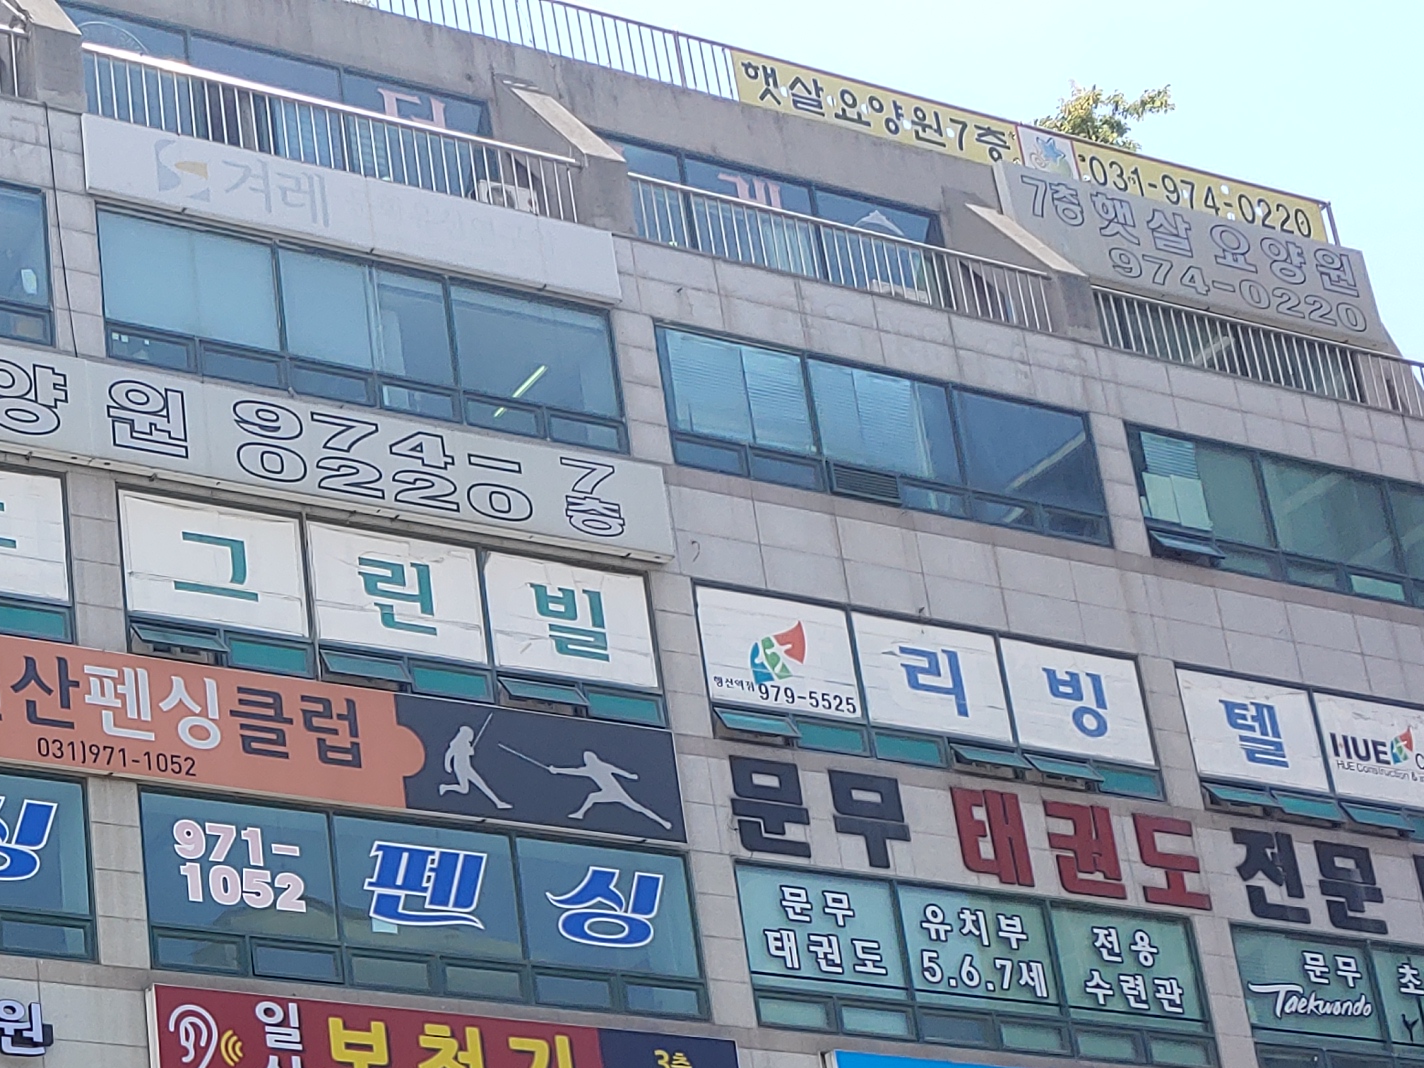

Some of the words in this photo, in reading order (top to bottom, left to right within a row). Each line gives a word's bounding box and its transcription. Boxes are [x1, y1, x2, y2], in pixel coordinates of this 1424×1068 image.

[1208, 222, 1362, 298] 요양원
[1110, 246, 1368, 333] 974-0220
[233, 401, 522, 474] 974-
[237, 442, 533, 522] 0220
[758, 683, 857, 714] 979-5525
[36, 736, 197, 777] 031)971-1052
[1329, 732, 1391, 765] HUE
[172, 818, 301, 867] 971-
[729, 754, 911, 869] 문무
[950, 786, 1212, 912] 태권도
[1229, 826, 1388, 935] 전문
[179, 862, 307, 914] 1052
[778, 884, 856, 927] 문무
[919, 901, 1030, 951] 유치부
[1092, 925, 1160, 969] 전용
[765, 925, 888, 977] 태권도
[920, 950, 1050, 1001] 5.6.7세
[1301, 950, 1363, 989] 문무
[1084, 967, 1185, 1015] 수련관
[1247, 981, 1373, 1019] Taekwondo
